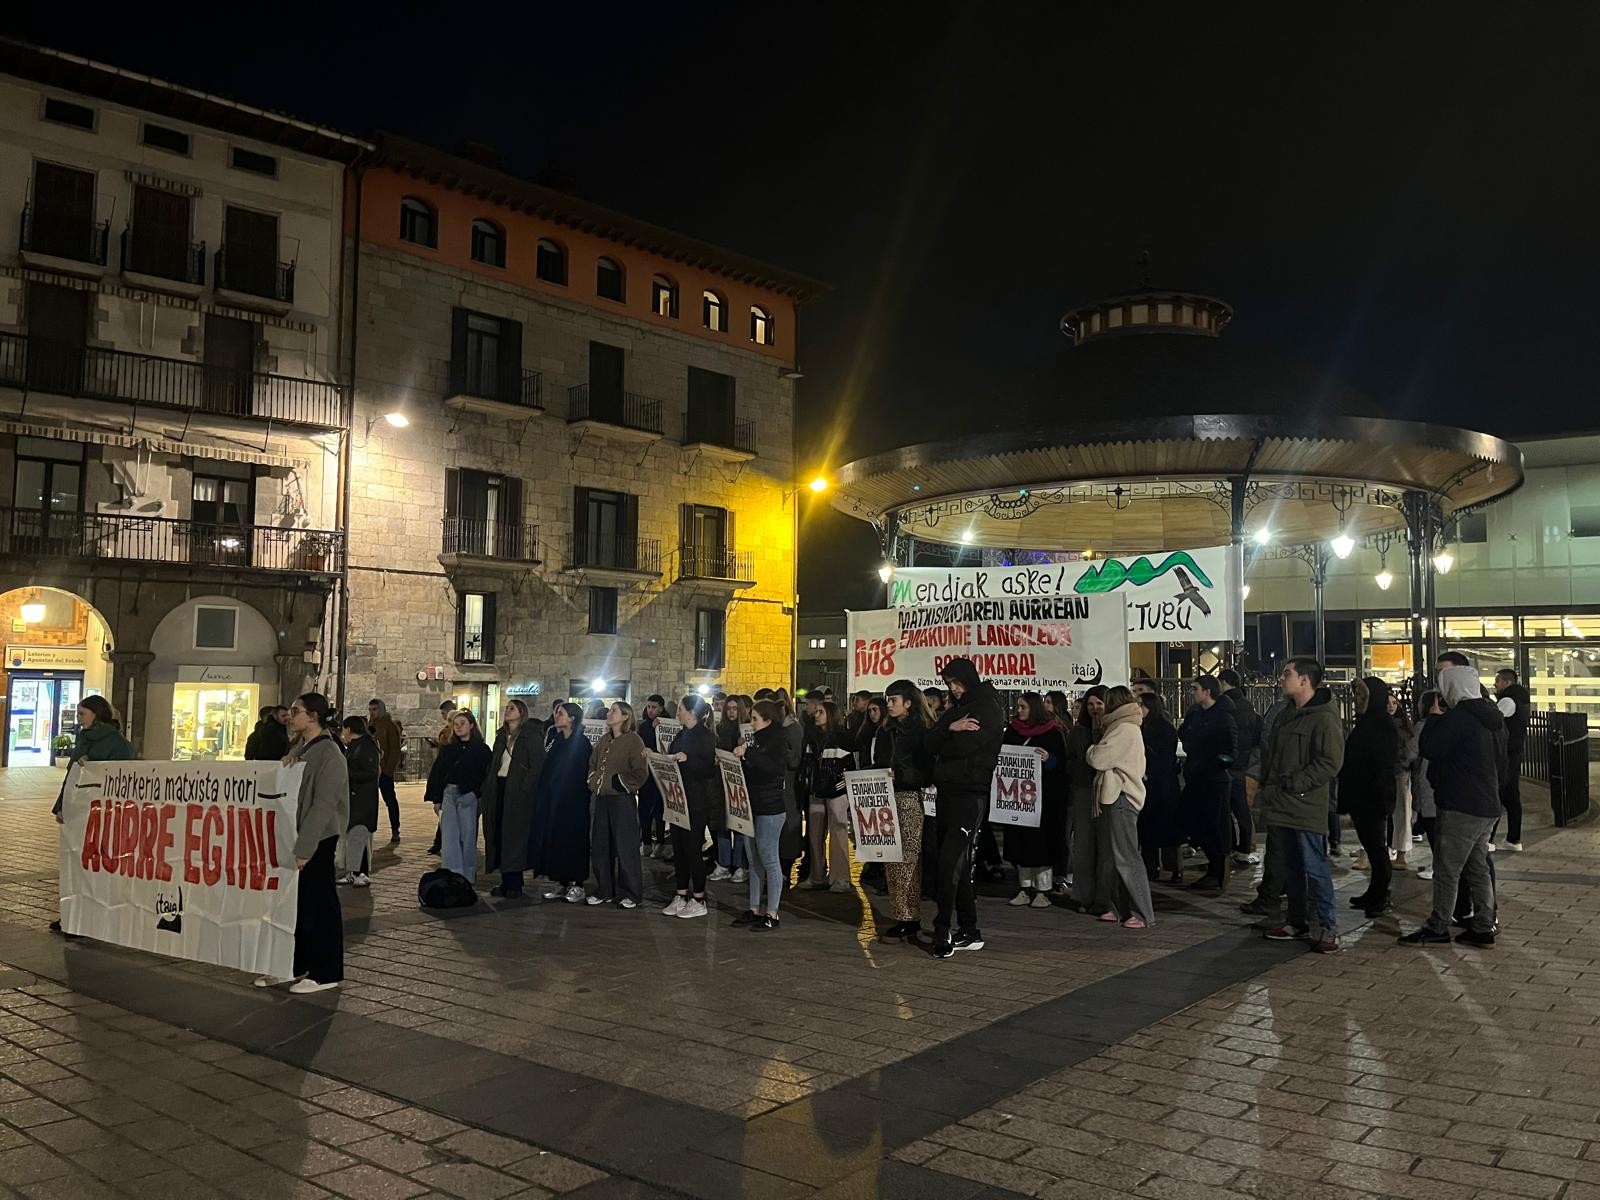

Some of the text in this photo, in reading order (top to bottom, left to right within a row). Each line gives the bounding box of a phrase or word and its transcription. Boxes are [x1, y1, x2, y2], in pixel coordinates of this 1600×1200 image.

[1009, 597, 1089, 621] AURREAN
[899, 624, 1072, 650] EMAKUME LANGILEOK
[855, 637, 897, 677] M8
[934, 653, 1037, 676] BOOKARA!
[1071, 663, 1096, 677] itaia
[1012, 677, 1030, 687] erail
[1030, 677, 1041, 687] du
[997, 755, 1035, 769] EMAKUME
[996, 766, 1035, 780] LANGILEOK
[165, 770, 219, 802] matxista
[224, 770, 258, 805] orori
[851, 782, 889, 796] EMAKUME
[995, 775, 1037, 805] M8
[853, 795, 890, 808] LANGILEOK
[996, 800, 1036, 813] BORROKARA
[854, 806, 896, 837] M8
[81, 799, 280, 891] AURRE EGIN!
[860, 834, 897, 846] BORROKARA
